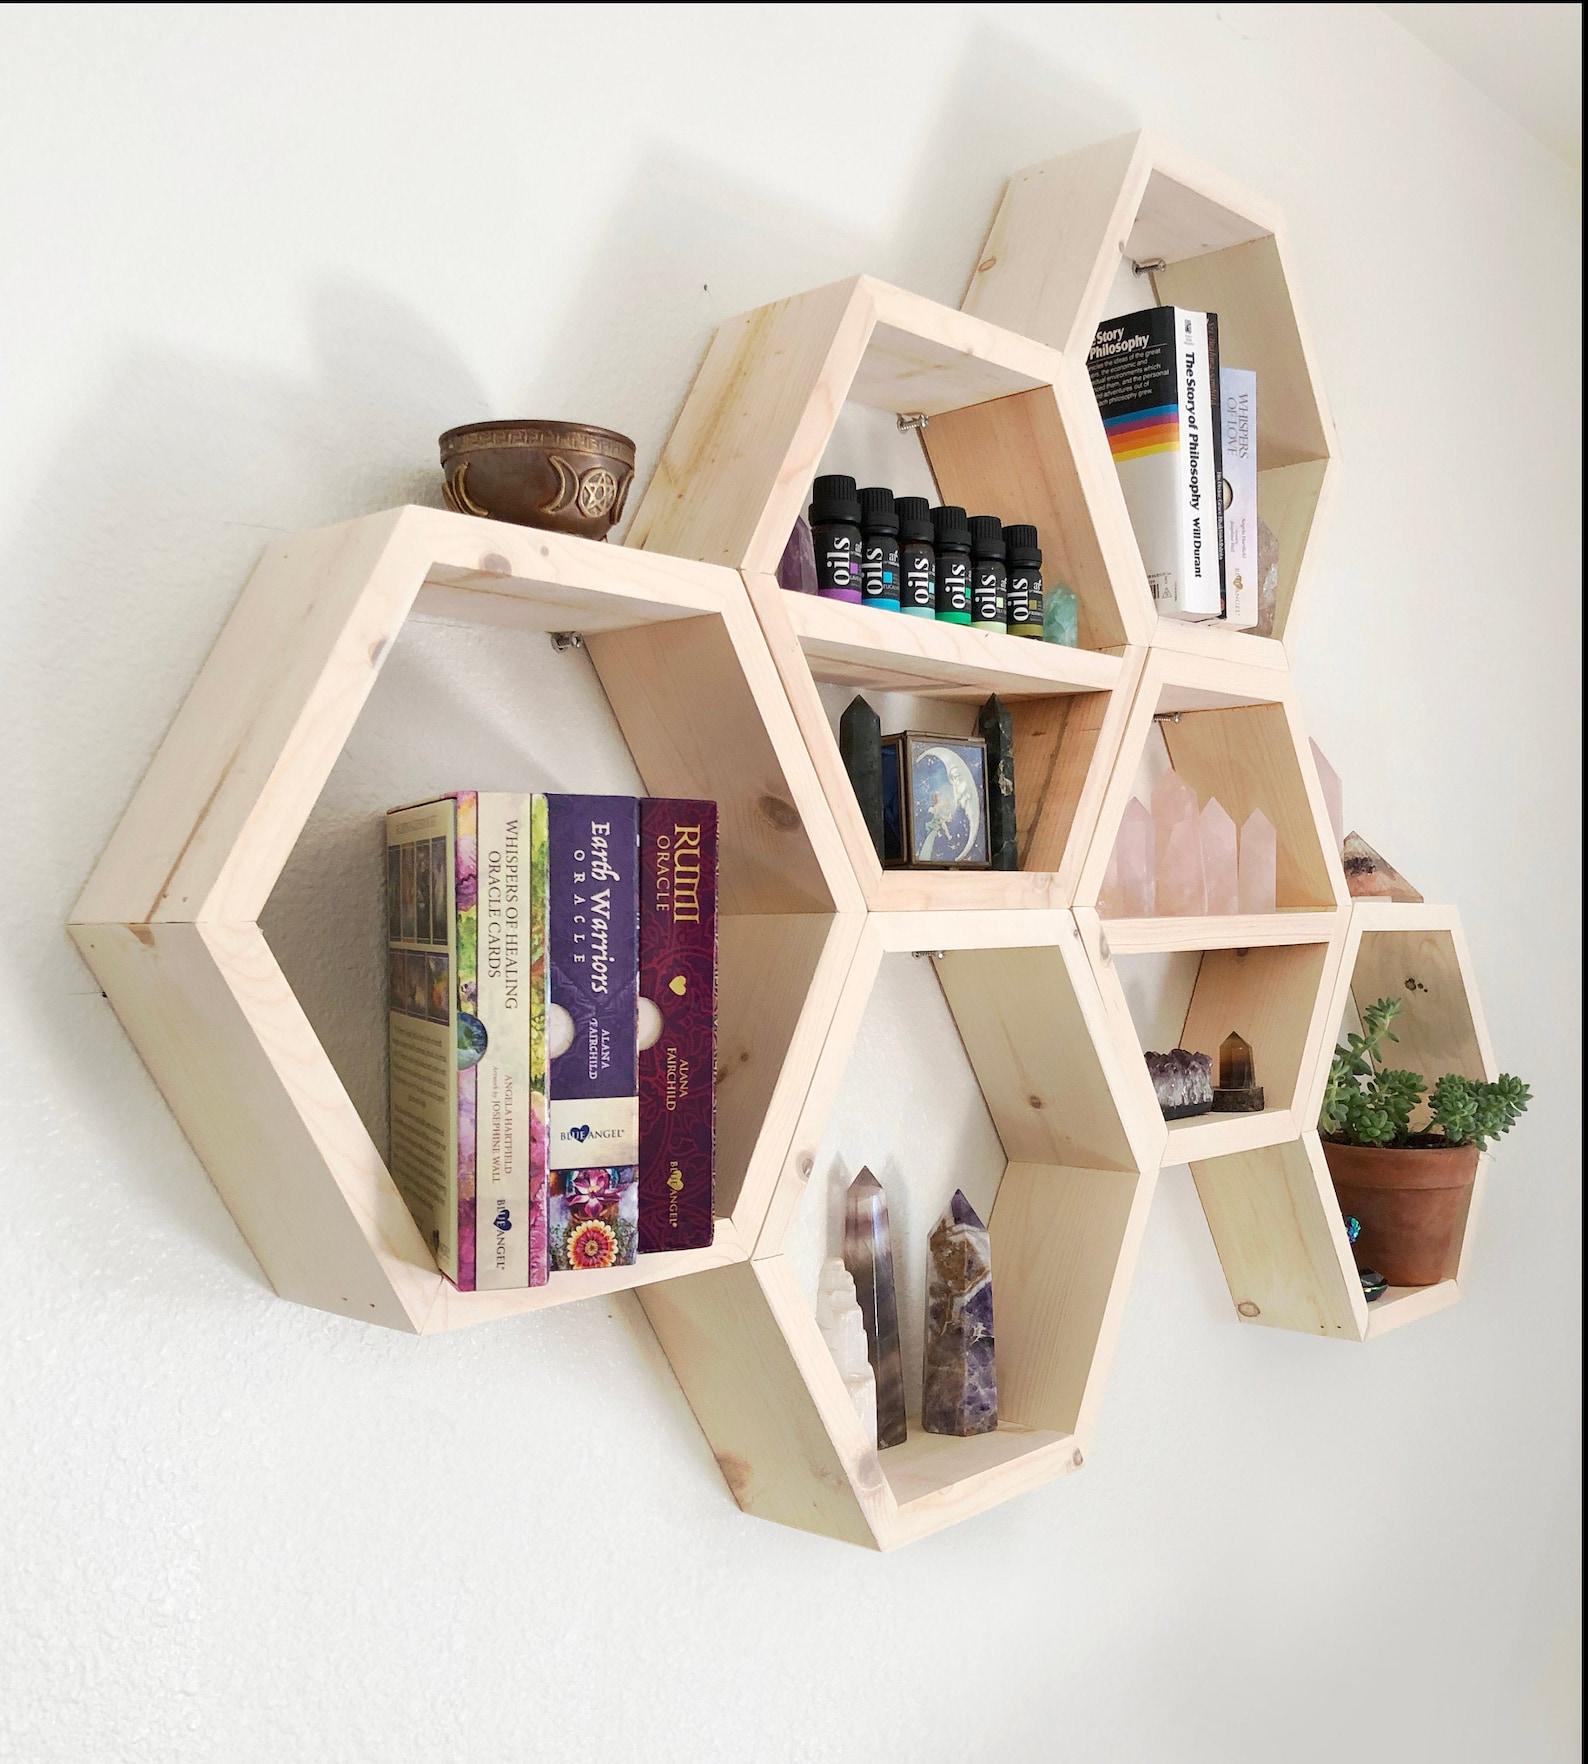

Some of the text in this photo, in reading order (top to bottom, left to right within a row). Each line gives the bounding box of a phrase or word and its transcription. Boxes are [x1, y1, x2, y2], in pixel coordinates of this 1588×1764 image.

[1090, 335, 1149, 360] Philosophy
[1097, 327, 1124, 344] Story
[1145, 348, 1161, 357] great
[1143, 369, 1169, 380] personal
[1186, 352, 1195, 377] The
[1109, 393, 1137, 404] philosophy
[1186, 377, 1196, 415] Story
[1188, 416, 1199, 430] of
[1227, 397, 1238, 456] OF LOVE
[1238, 394, 1249, 459] WHISPERS
[1189, 433, 1201, 510] Philosophy
[1192, 517, 1201, 536] Will
[827, 537, 850, 586] oils
[862, 548, 883, 595] oils
[1194, 537, 1202, 578] Durant
[908, 558, 929, 604] oils
[945, 564, 966, 609] oils
[975, 574, 996, 618] oils
[1007, 578, 1029, 621] oils
[656, 835, 670, 912] ORACLE
[674, 824, 700, 924] RUMI
[488, 850, 501, 978] ORACLE CARDS
[505, 820, 518, 1009] WHISPERS OF HEALING
[574, 850, 586, 963] ORACLE
[590, 821, 620, 994] Earth Warriors
[589, 1018, 598, 1080] FAIRCHILD
[601, 1029, 610, 1069] ALANA
[666, 1047, 677, 1111] FAIRCHILD
[679, 1059, 689, 1098] ALANA
[491, 1101, 501, 1154] JOSEPHINE
[504, 1074, 513, 1174] ANGELA HARTFIELD
[492, 1156, 501, 1184] WALL
